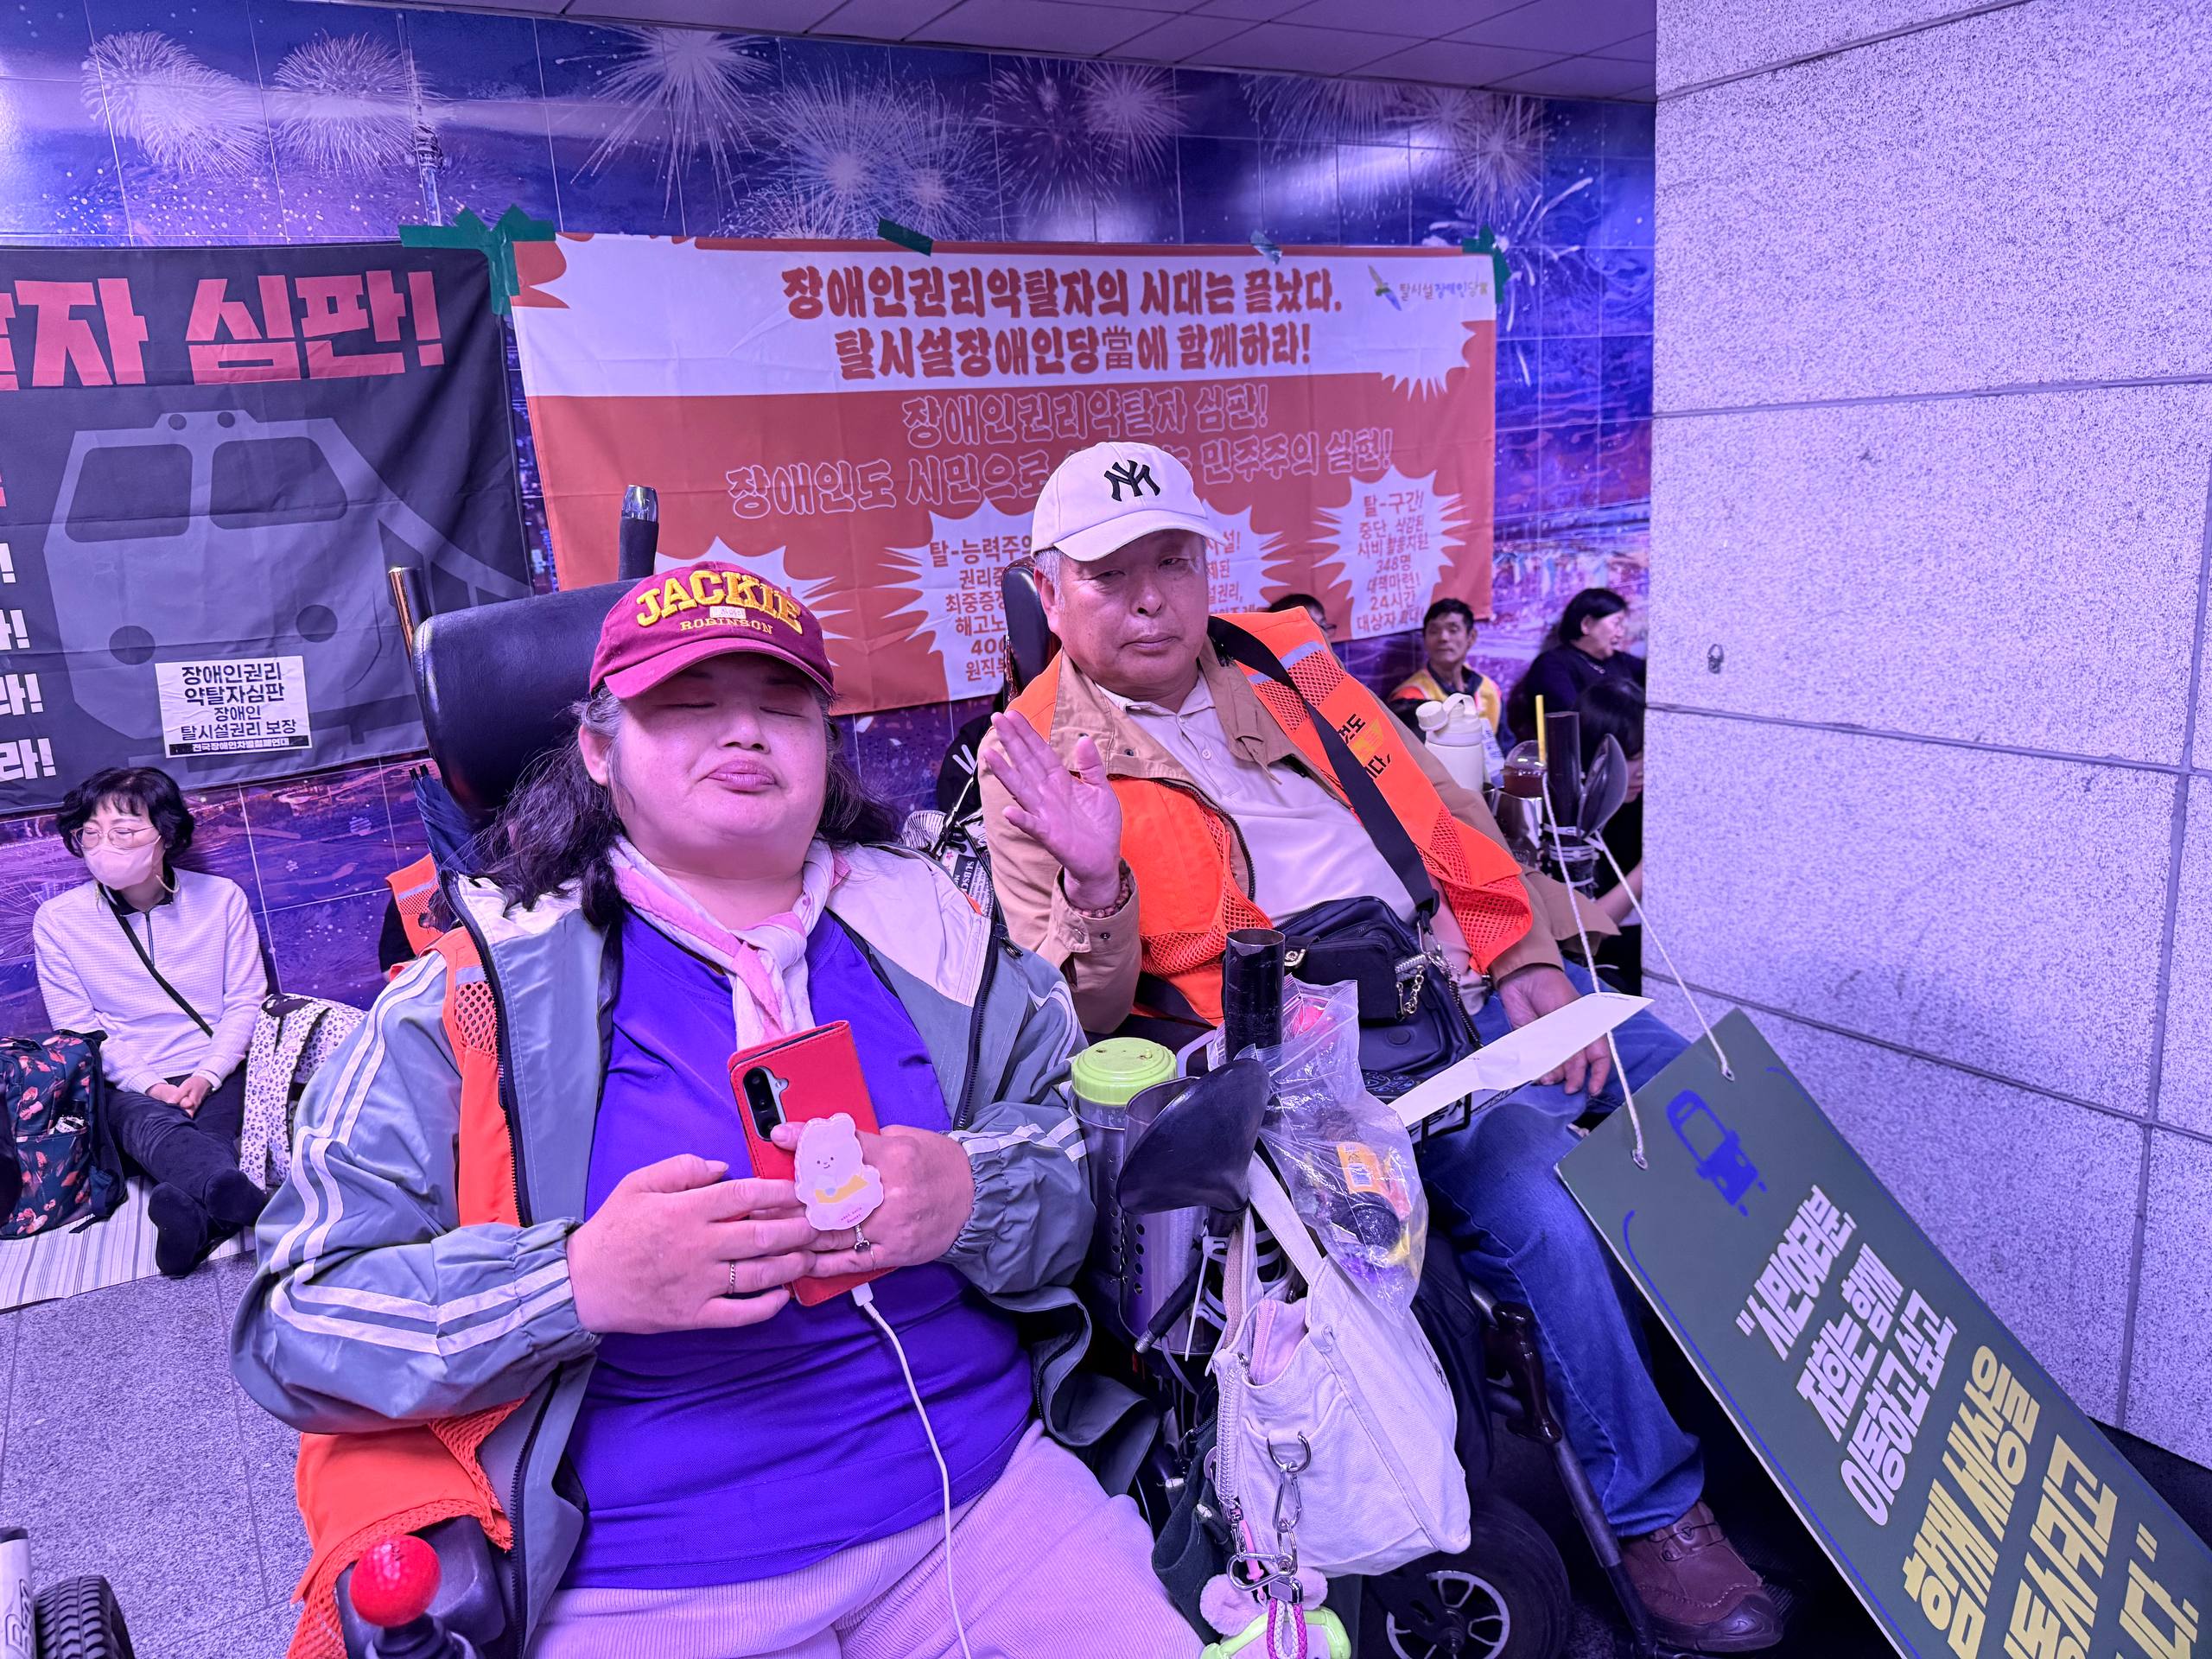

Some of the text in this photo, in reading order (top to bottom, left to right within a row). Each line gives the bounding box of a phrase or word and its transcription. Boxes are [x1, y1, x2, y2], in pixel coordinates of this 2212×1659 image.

[782, 265, 1342, 319] 장애인권리약탈자의 시대는 끝났다.
[0, 270, 444, 391] 자 심판!
[1177, 323, 1311, 370] 함께하라!
[902, 384, 1268, 448] 장애인권리약탈자 심판!
[726, 459, 896, 518] 장애인도
[906, 449, 1049, 505] 시민으로
[1200, 431, 1319, 485] 민주주의
[1325, 428, 1393, 474] 실현!
[1103, 459, 1160, 502] NY
[636, 570, 803, 635] JACKIE
[680, 616, 773, 635] ROBINSON
[1357, 611, 1396, 632] 대상자
[181, 662, 282, 686] 장애인권리
[184, 683, 285, 706] 약탈자심판
[181, 719, 296, 741] 탈시설권리 보장
[213, 705, 262, 722] 장애인
[1796, 1243, 1903, 1442] 저희는 함께
[1841, 1350, 1928, 1525] 이동하고
[1904, 1346, 2040, 1659] 함께 세상을
